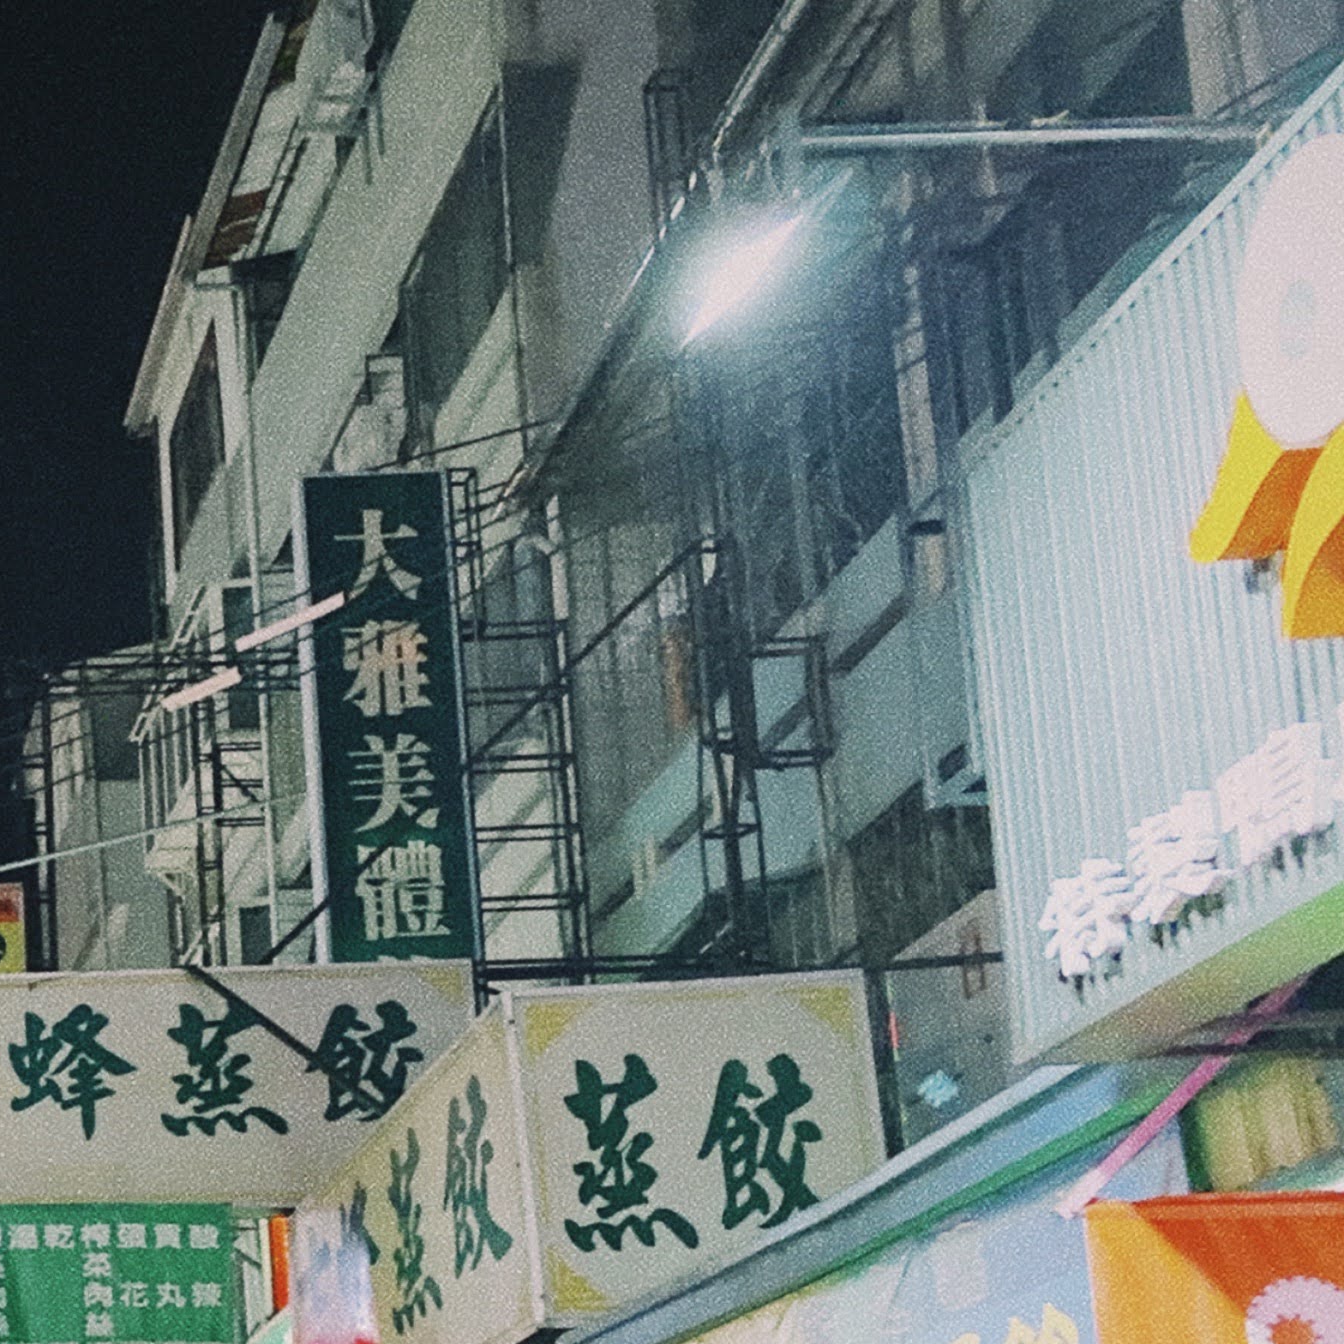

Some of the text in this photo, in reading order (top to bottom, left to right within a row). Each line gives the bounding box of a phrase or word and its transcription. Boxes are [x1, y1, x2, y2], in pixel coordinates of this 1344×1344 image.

[334, 508, 451, 941] 大雅美體
[561, 1052, 825, 1252] 蒸餃
